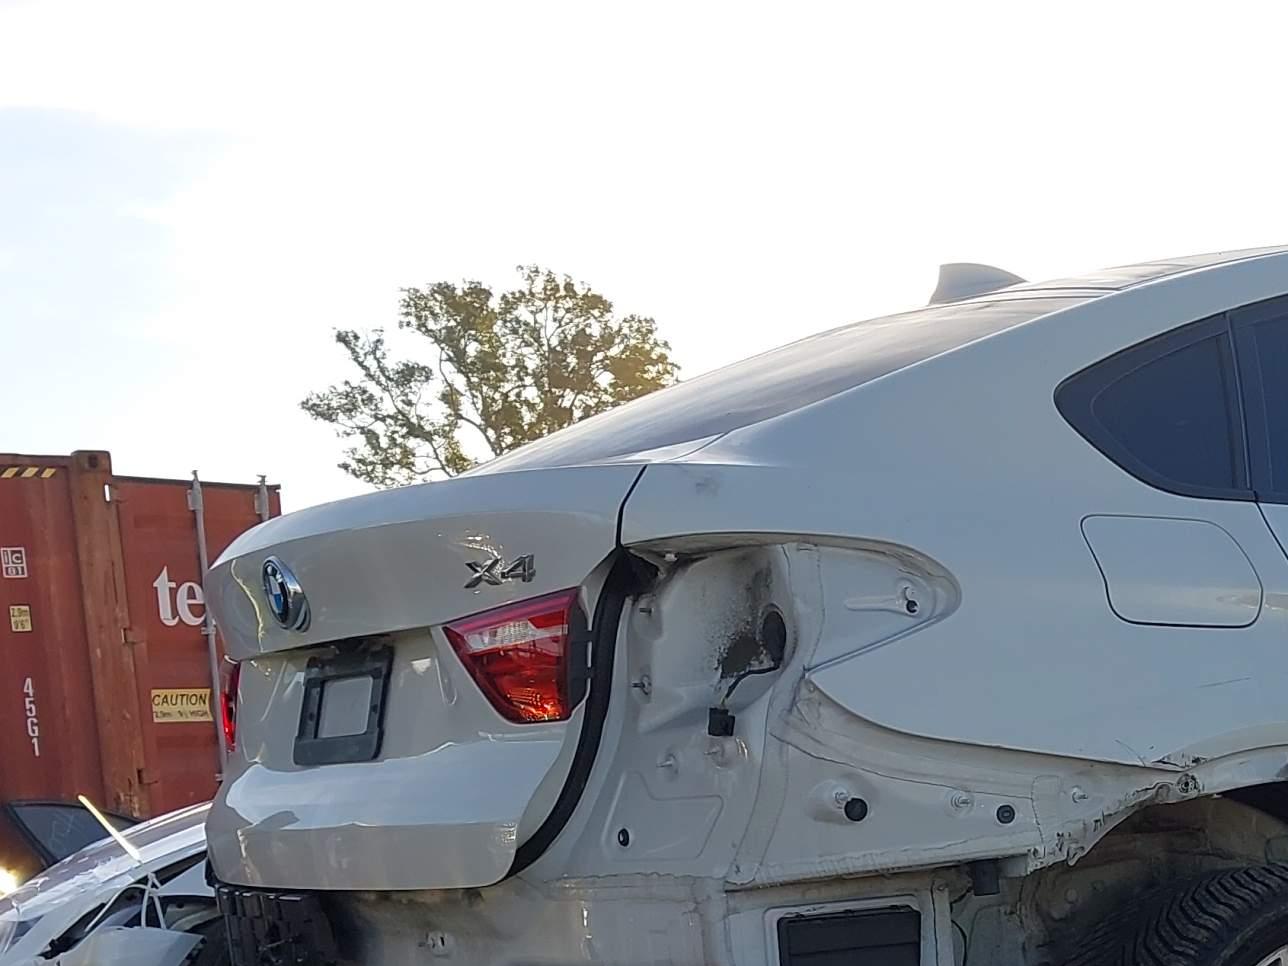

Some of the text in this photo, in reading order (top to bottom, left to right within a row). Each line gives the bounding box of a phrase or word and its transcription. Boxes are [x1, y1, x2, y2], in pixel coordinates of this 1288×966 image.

[464, 553, 536, 589] X4
[23, 677, 40, 757] 45G1
[152, 693, 207, 706] CAUTION
